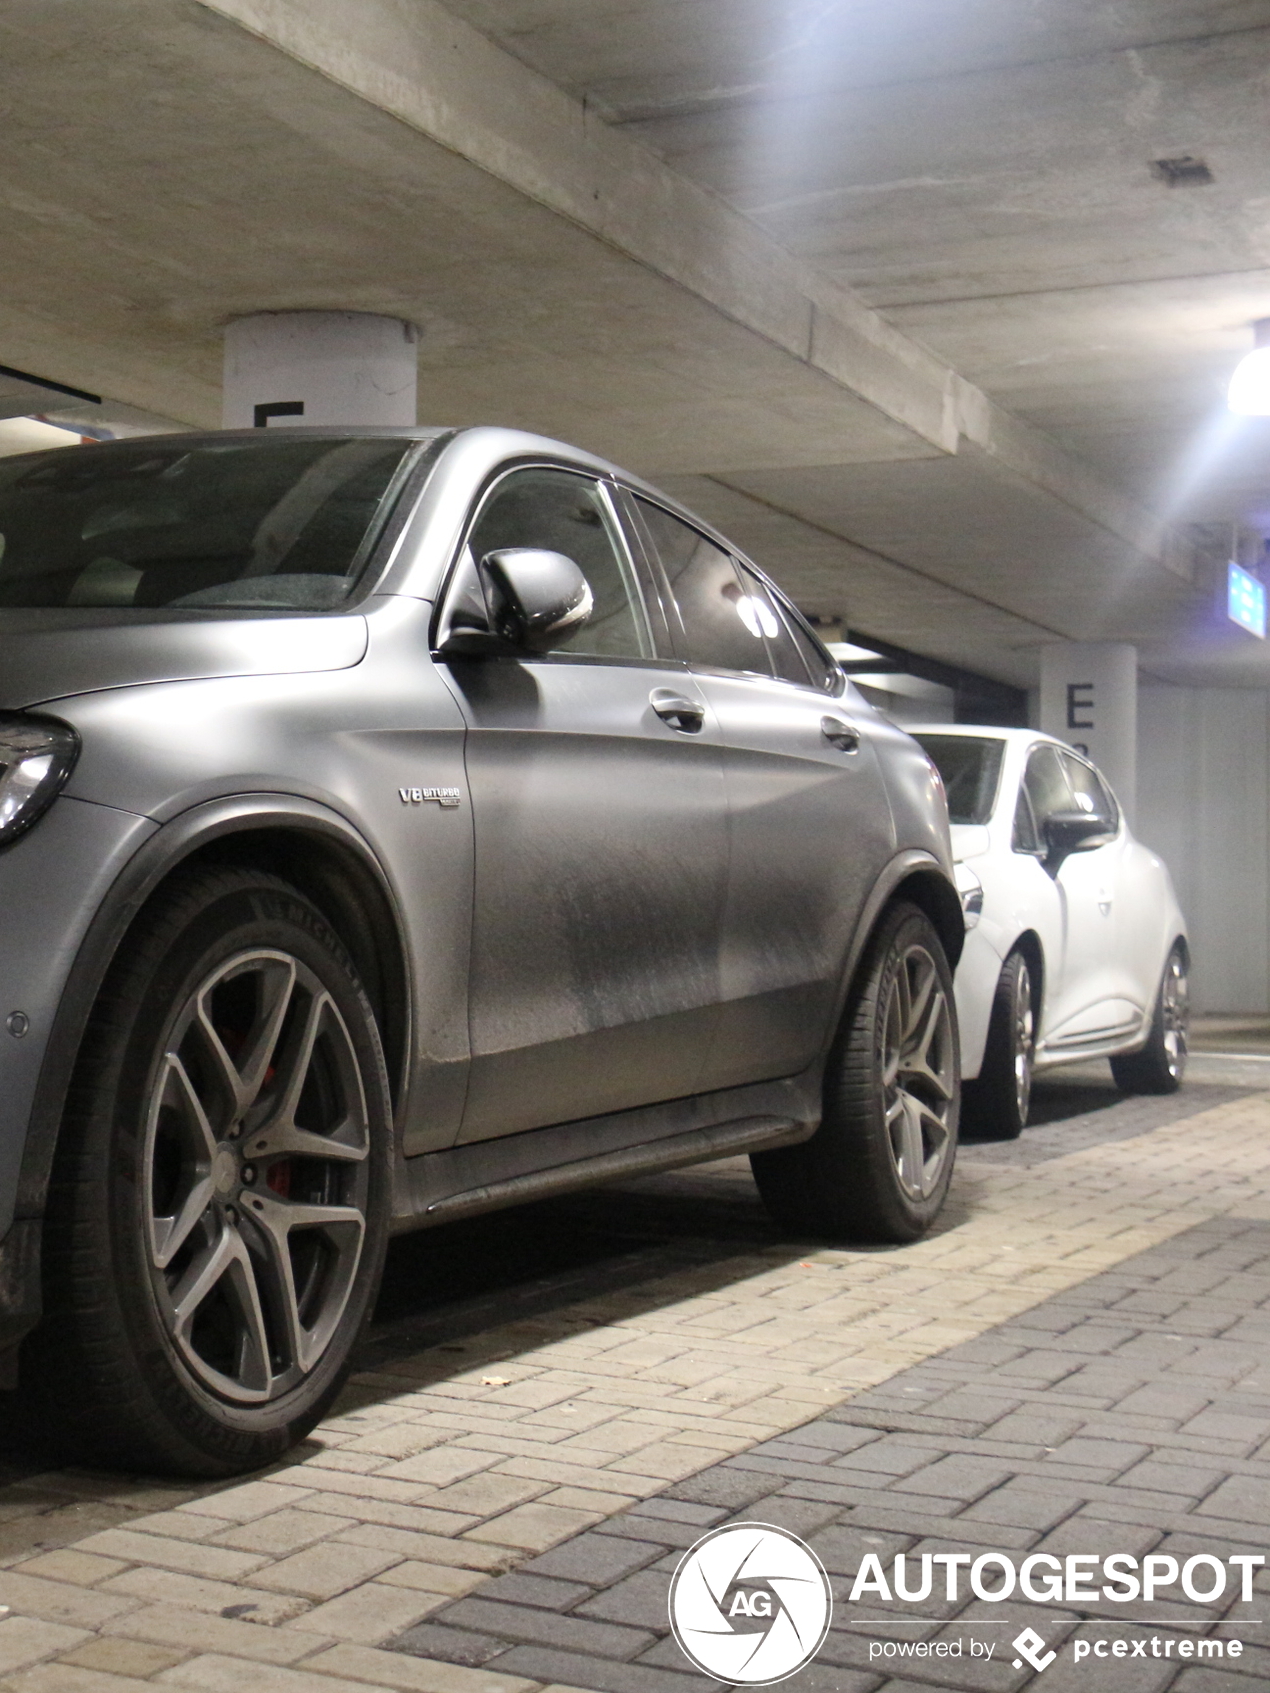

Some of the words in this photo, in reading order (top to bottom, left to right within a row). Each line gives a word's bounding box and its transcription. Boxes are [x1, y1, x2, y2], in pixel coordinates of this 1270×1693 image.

[1067, 684, 1093, 729] E
[399, 788, 422, 802] V8
[423, 788, 460, 797] BITURBO
